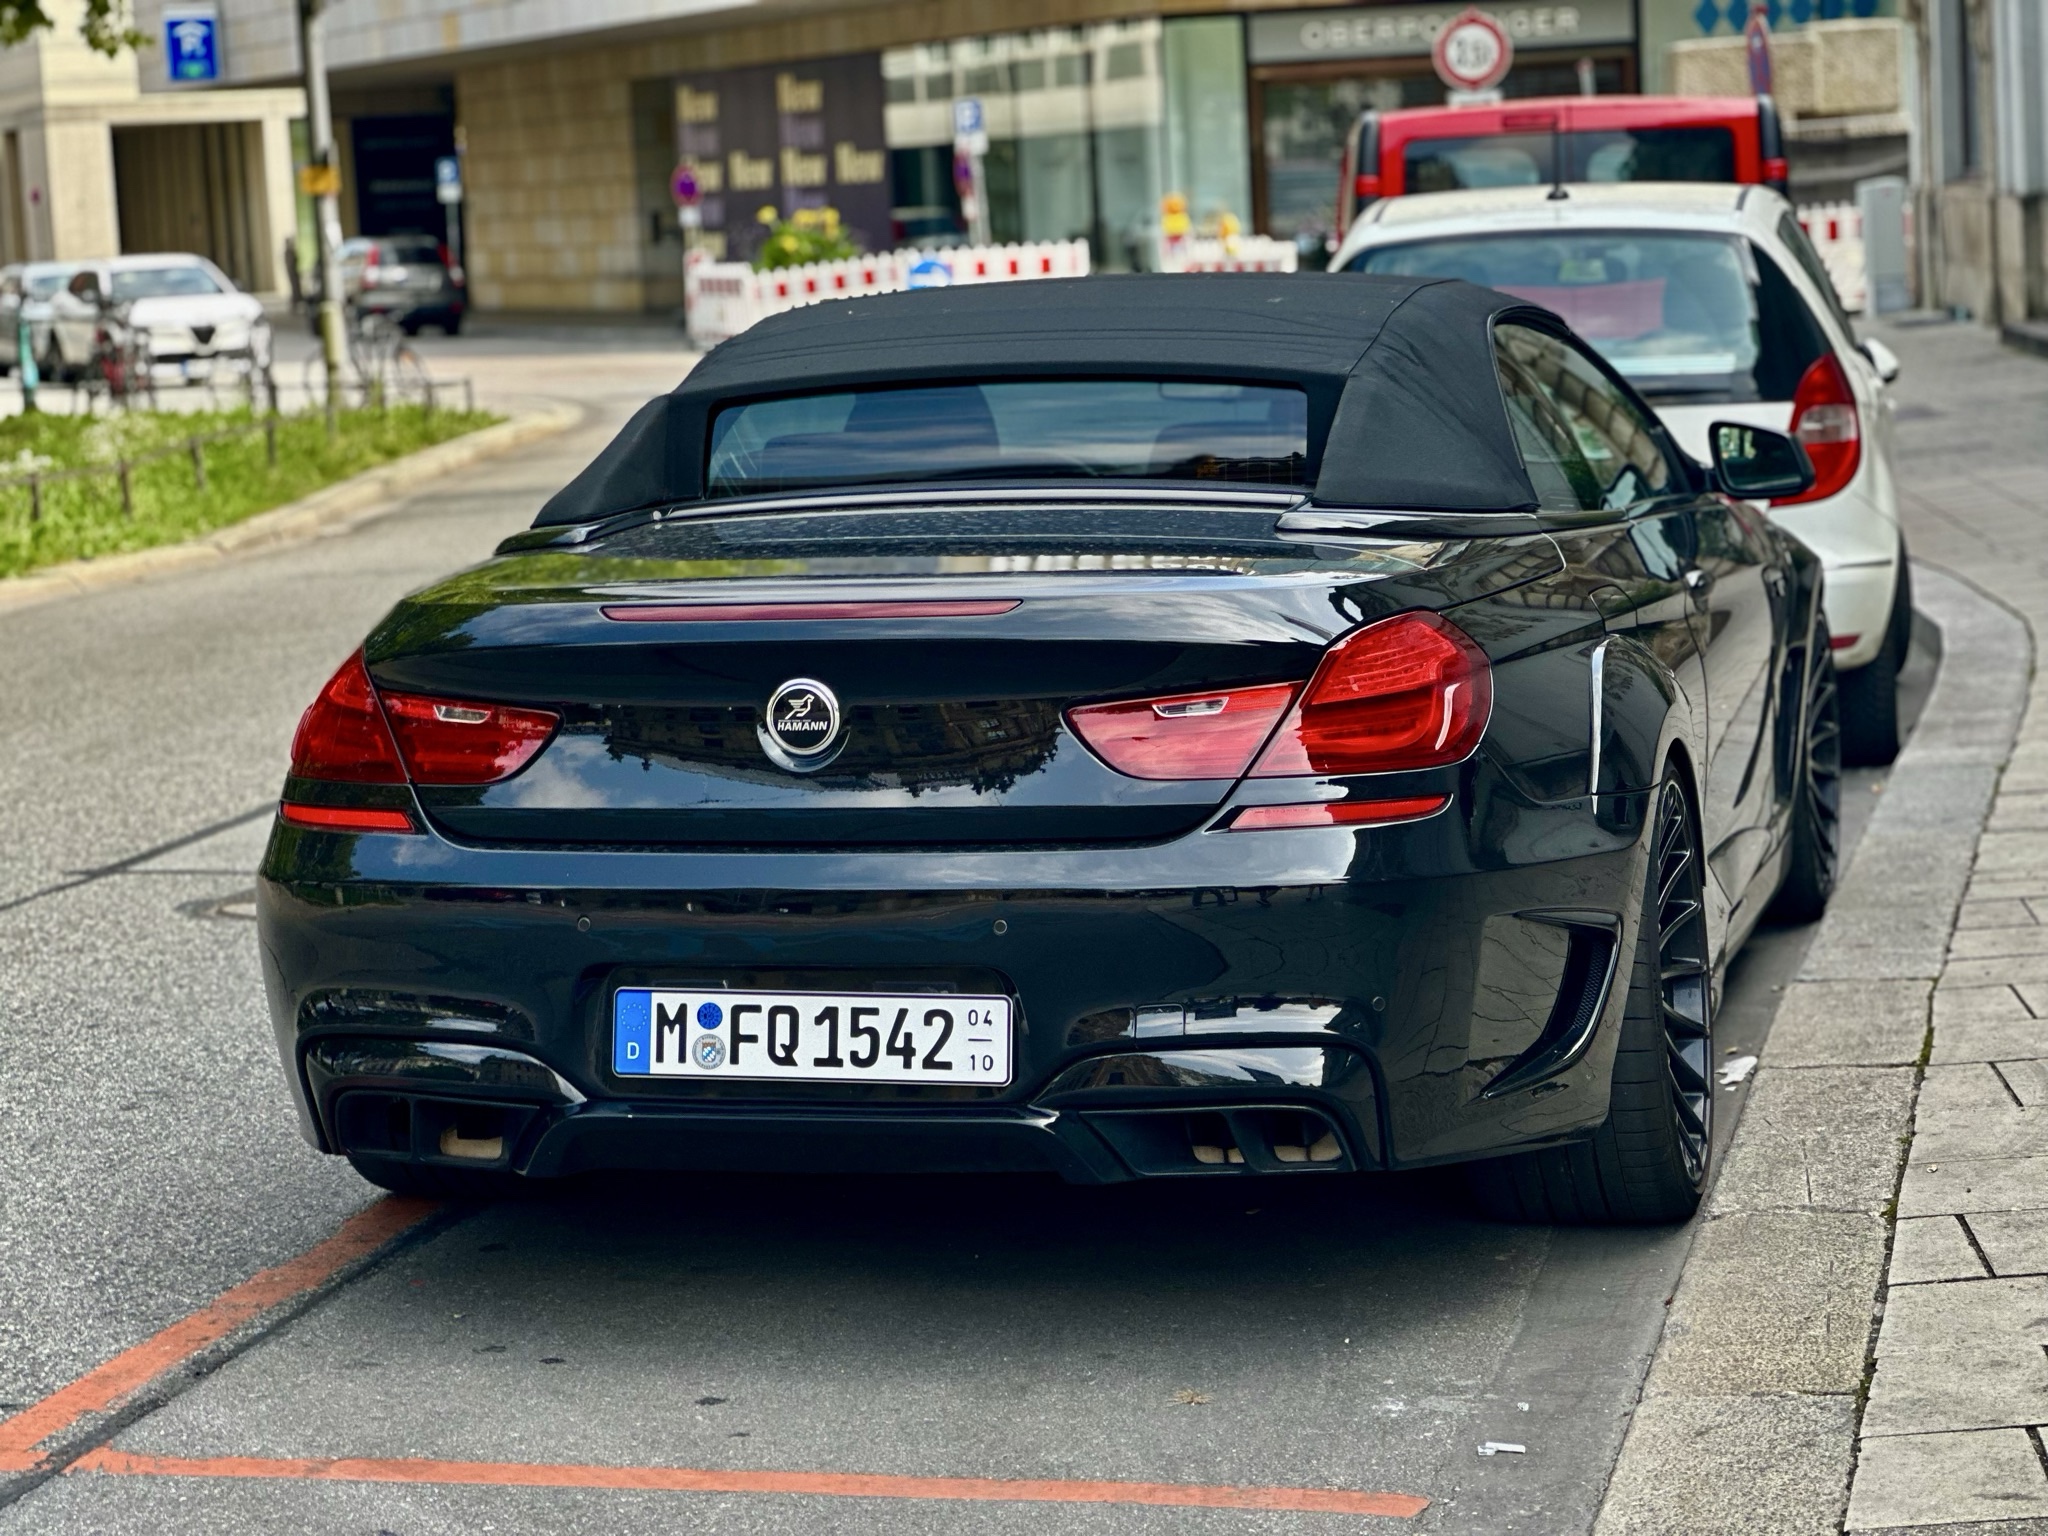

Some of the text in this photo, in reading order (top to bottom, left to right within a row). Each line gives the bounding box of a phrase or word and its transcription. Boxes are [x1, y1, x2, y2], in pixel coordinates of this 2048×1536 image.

[777, 721, 828, 731] HAMANN
[968, 1009, 993, 1027] 04
[656, 1002, 688, 1063] M
[626, 1042, 640, 1060] D
[970, 1054, 994, 1071] 10
